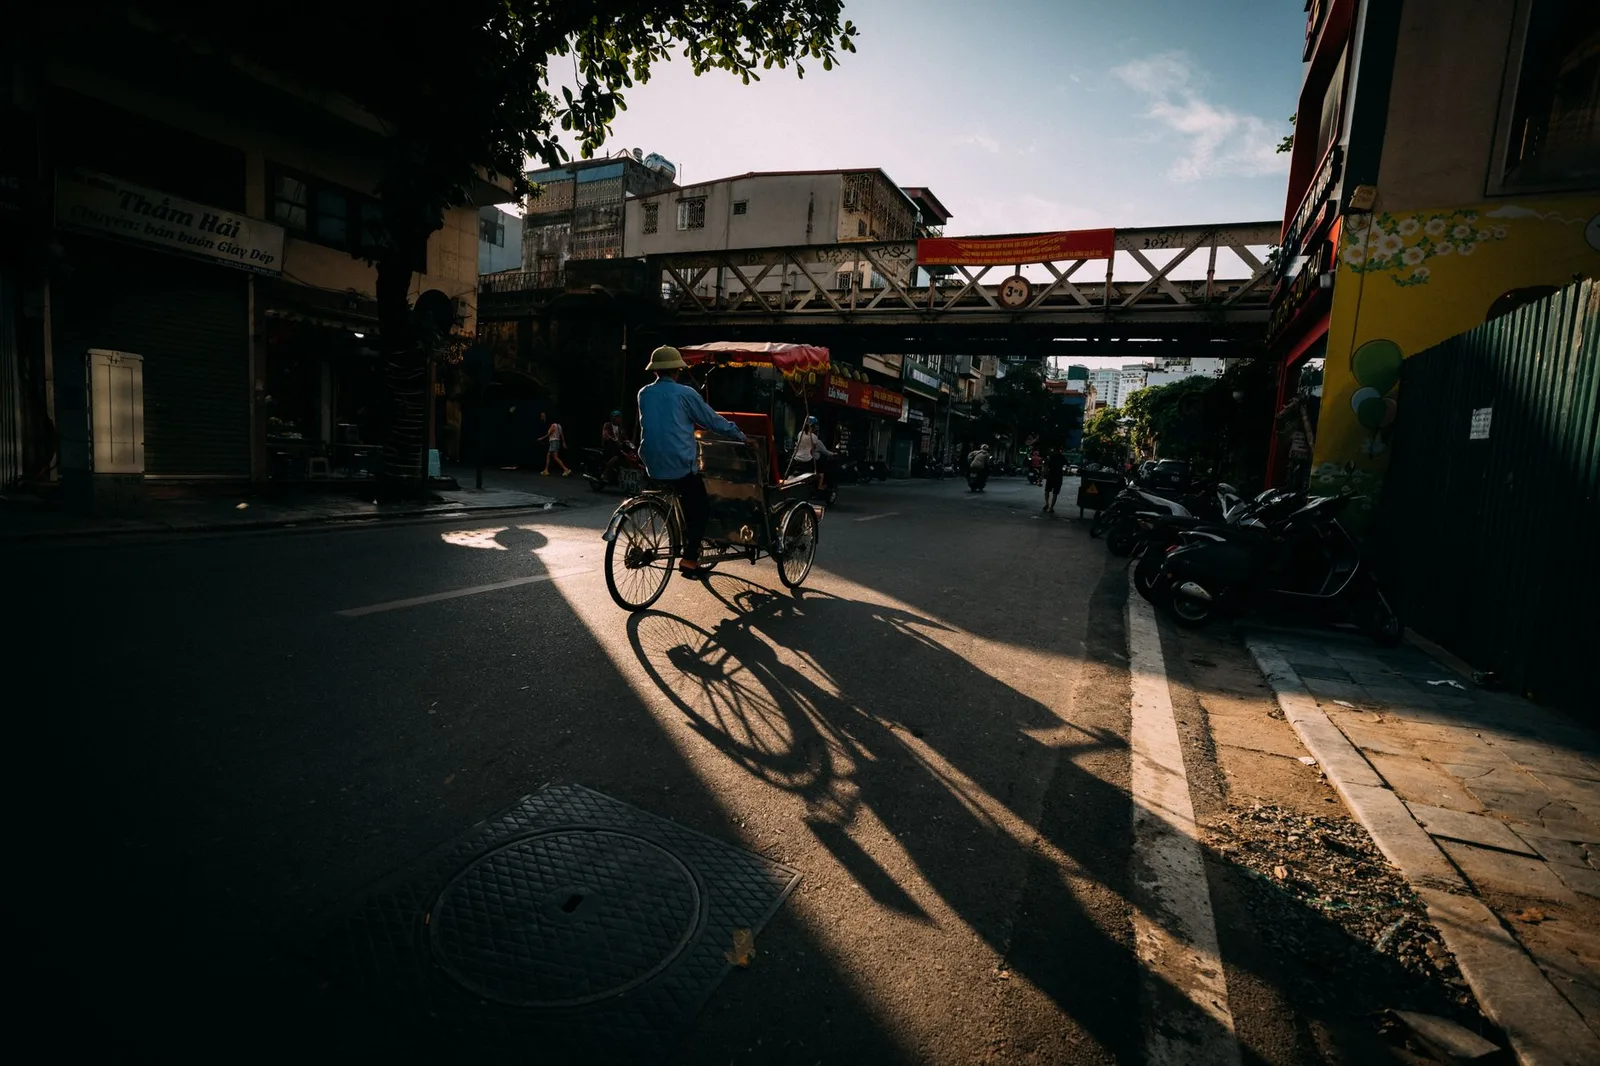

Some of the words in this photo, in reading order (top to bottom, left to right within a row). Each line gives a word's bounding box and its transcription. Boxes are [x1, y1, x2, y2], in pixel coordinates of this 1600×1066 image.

[199, 213, 241, 239] Hải
[177, 231, 214, 249] buôn
[249, 248, 274, 265] Dép
[871, 245, 912, 260] TASK
